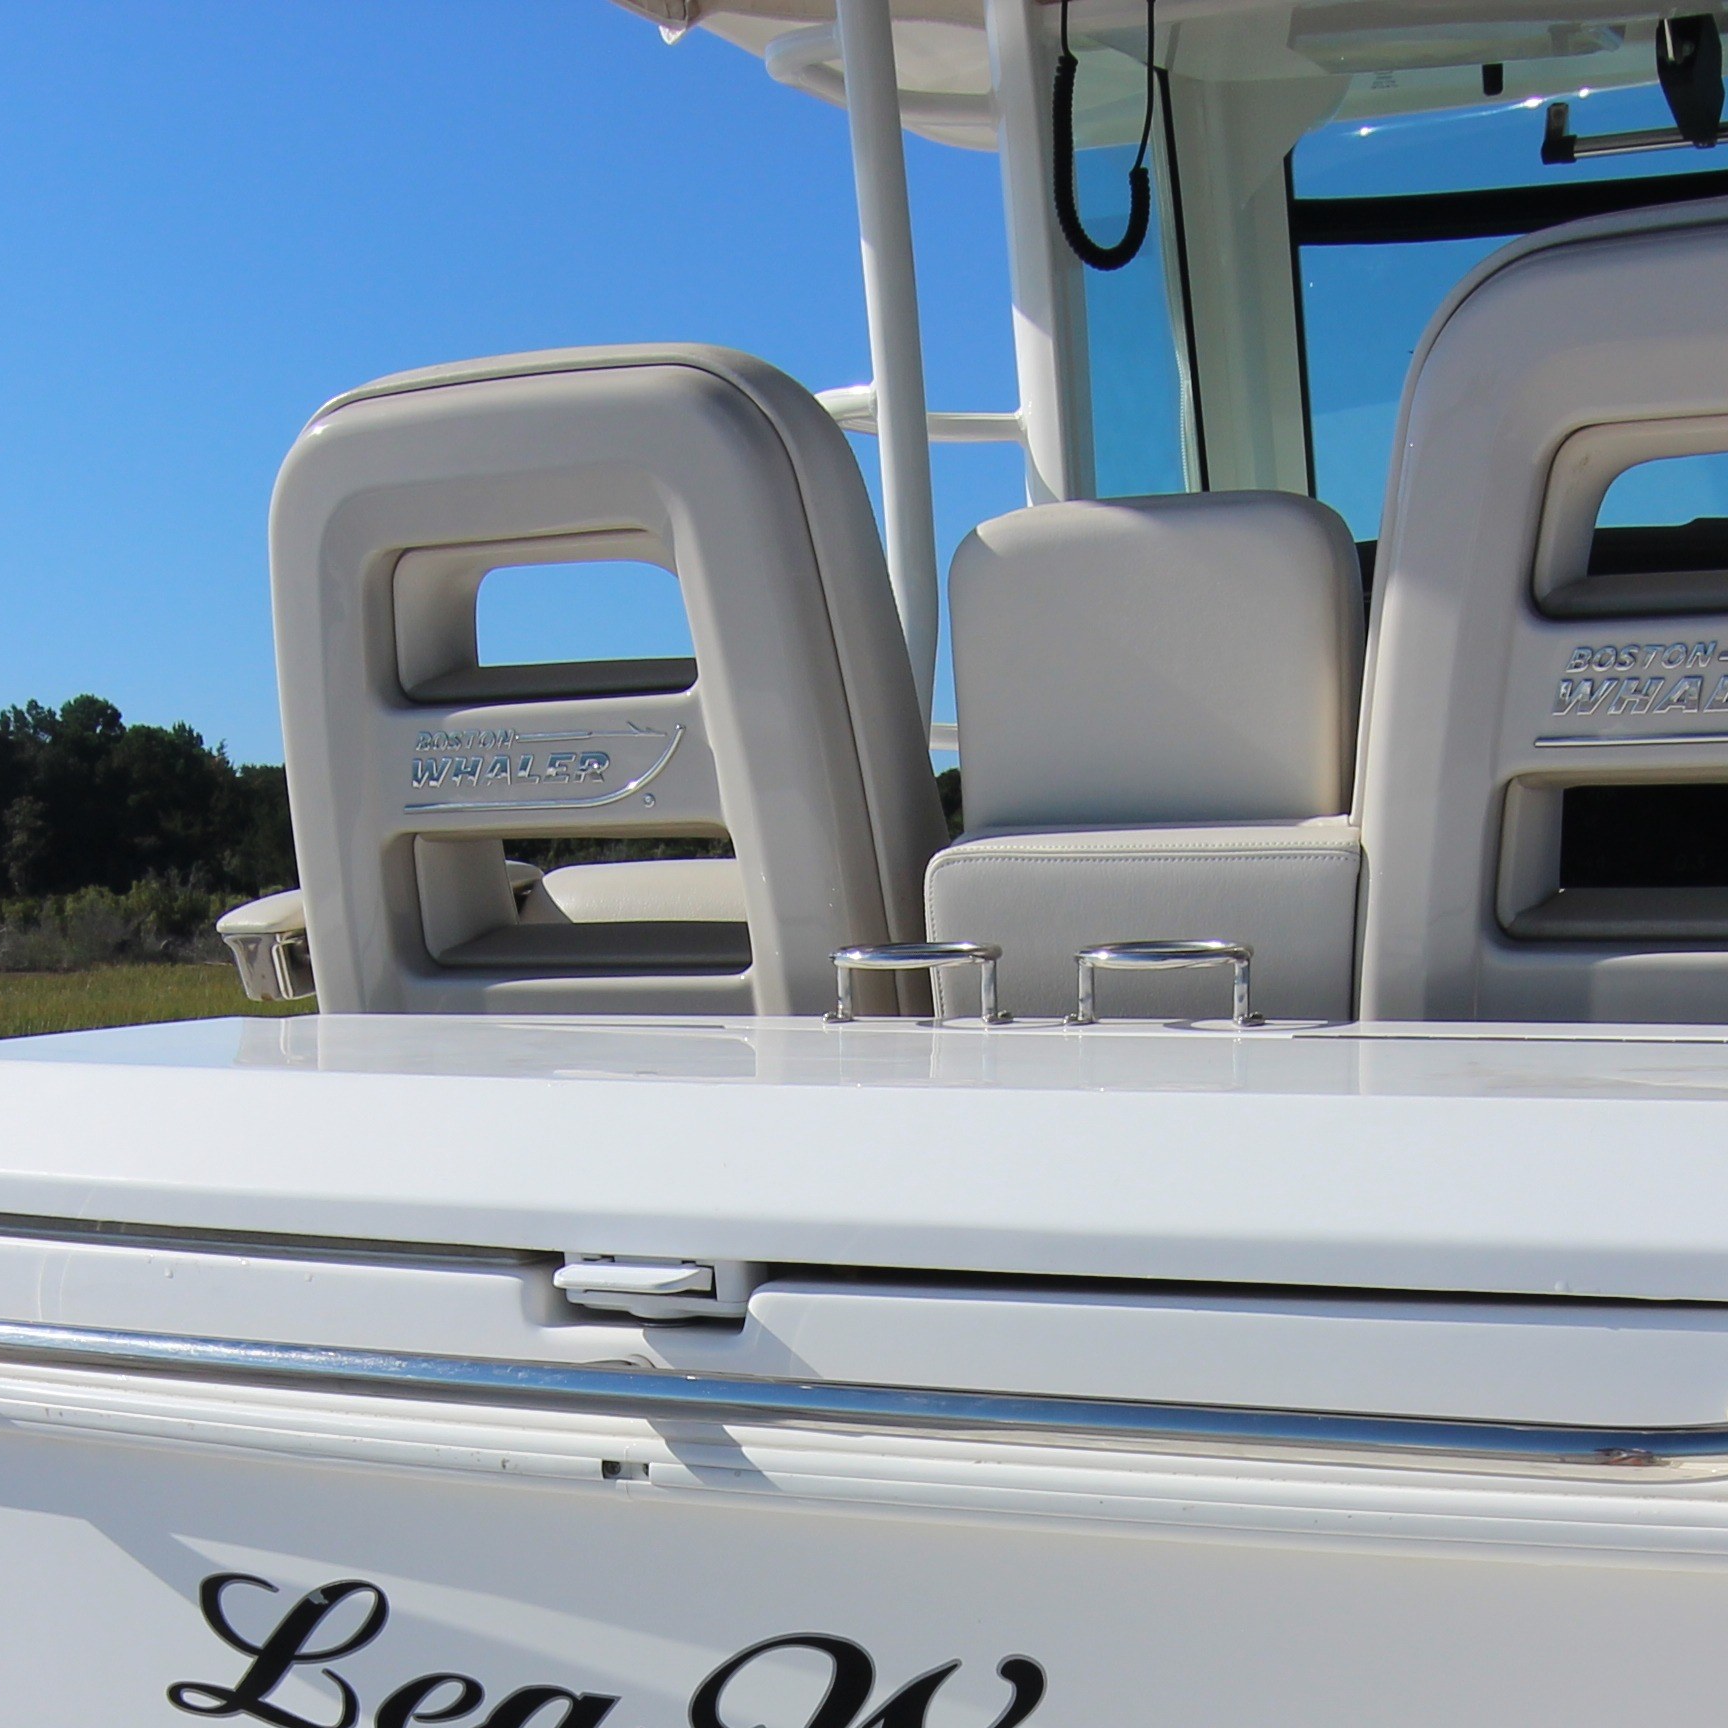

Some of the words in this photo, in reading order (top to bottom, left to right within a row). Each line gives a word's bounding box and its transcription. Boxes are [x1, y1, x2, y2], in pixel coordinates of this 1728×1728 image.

[1566, 640, 1719, 673] BOSTON
[415, 728, 515, 752] BOSTON
[410, 752, 611, 789] WHALER
